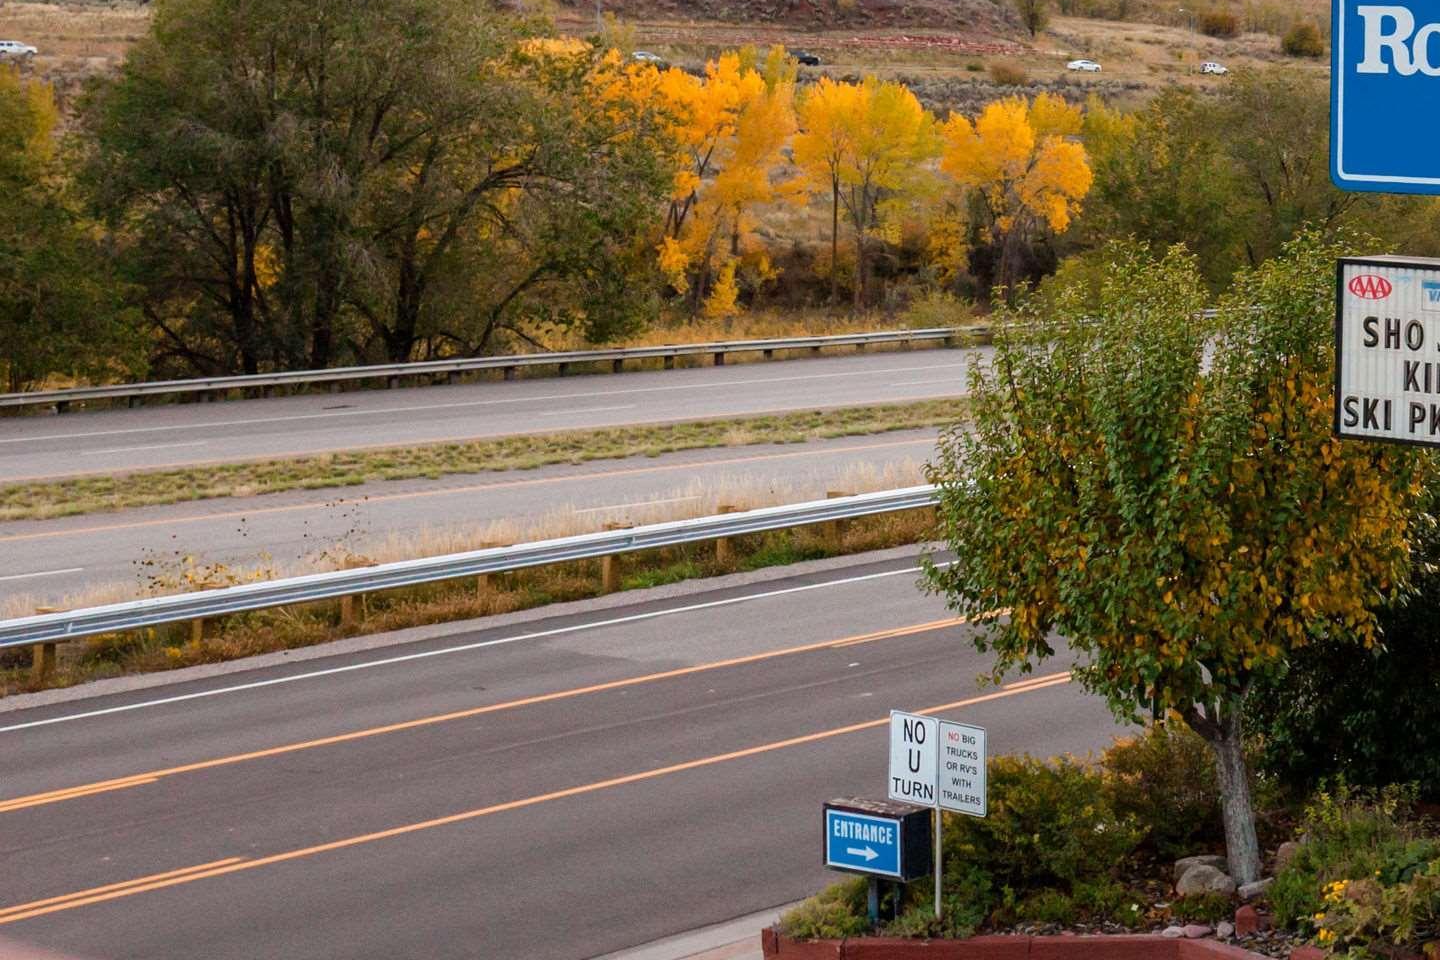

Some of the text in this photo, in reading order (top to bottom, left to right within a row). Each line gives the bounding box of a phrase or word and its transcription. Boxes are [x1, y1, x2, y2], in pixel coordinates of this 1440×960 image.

[1352, 275, 1387, 299] AAA
[1363, 315, 1424, 352] SHO
[1343, 395, 1392, 431] SKI
[903, 718, 926, 745] NO
[947, 731, 976, 745] NO BIG
[908, 748, 921, 773] U
[946, 746, 978, 761] TRUCKS
[946, 761, 978, 776] OR RV'S
[892, 776, 934, 801] TURN
[951, 777, 972, 789] WITH
[943, 790, 981, 806] TRAILERS
[834, 819, 893, 845] ENTRANCE
